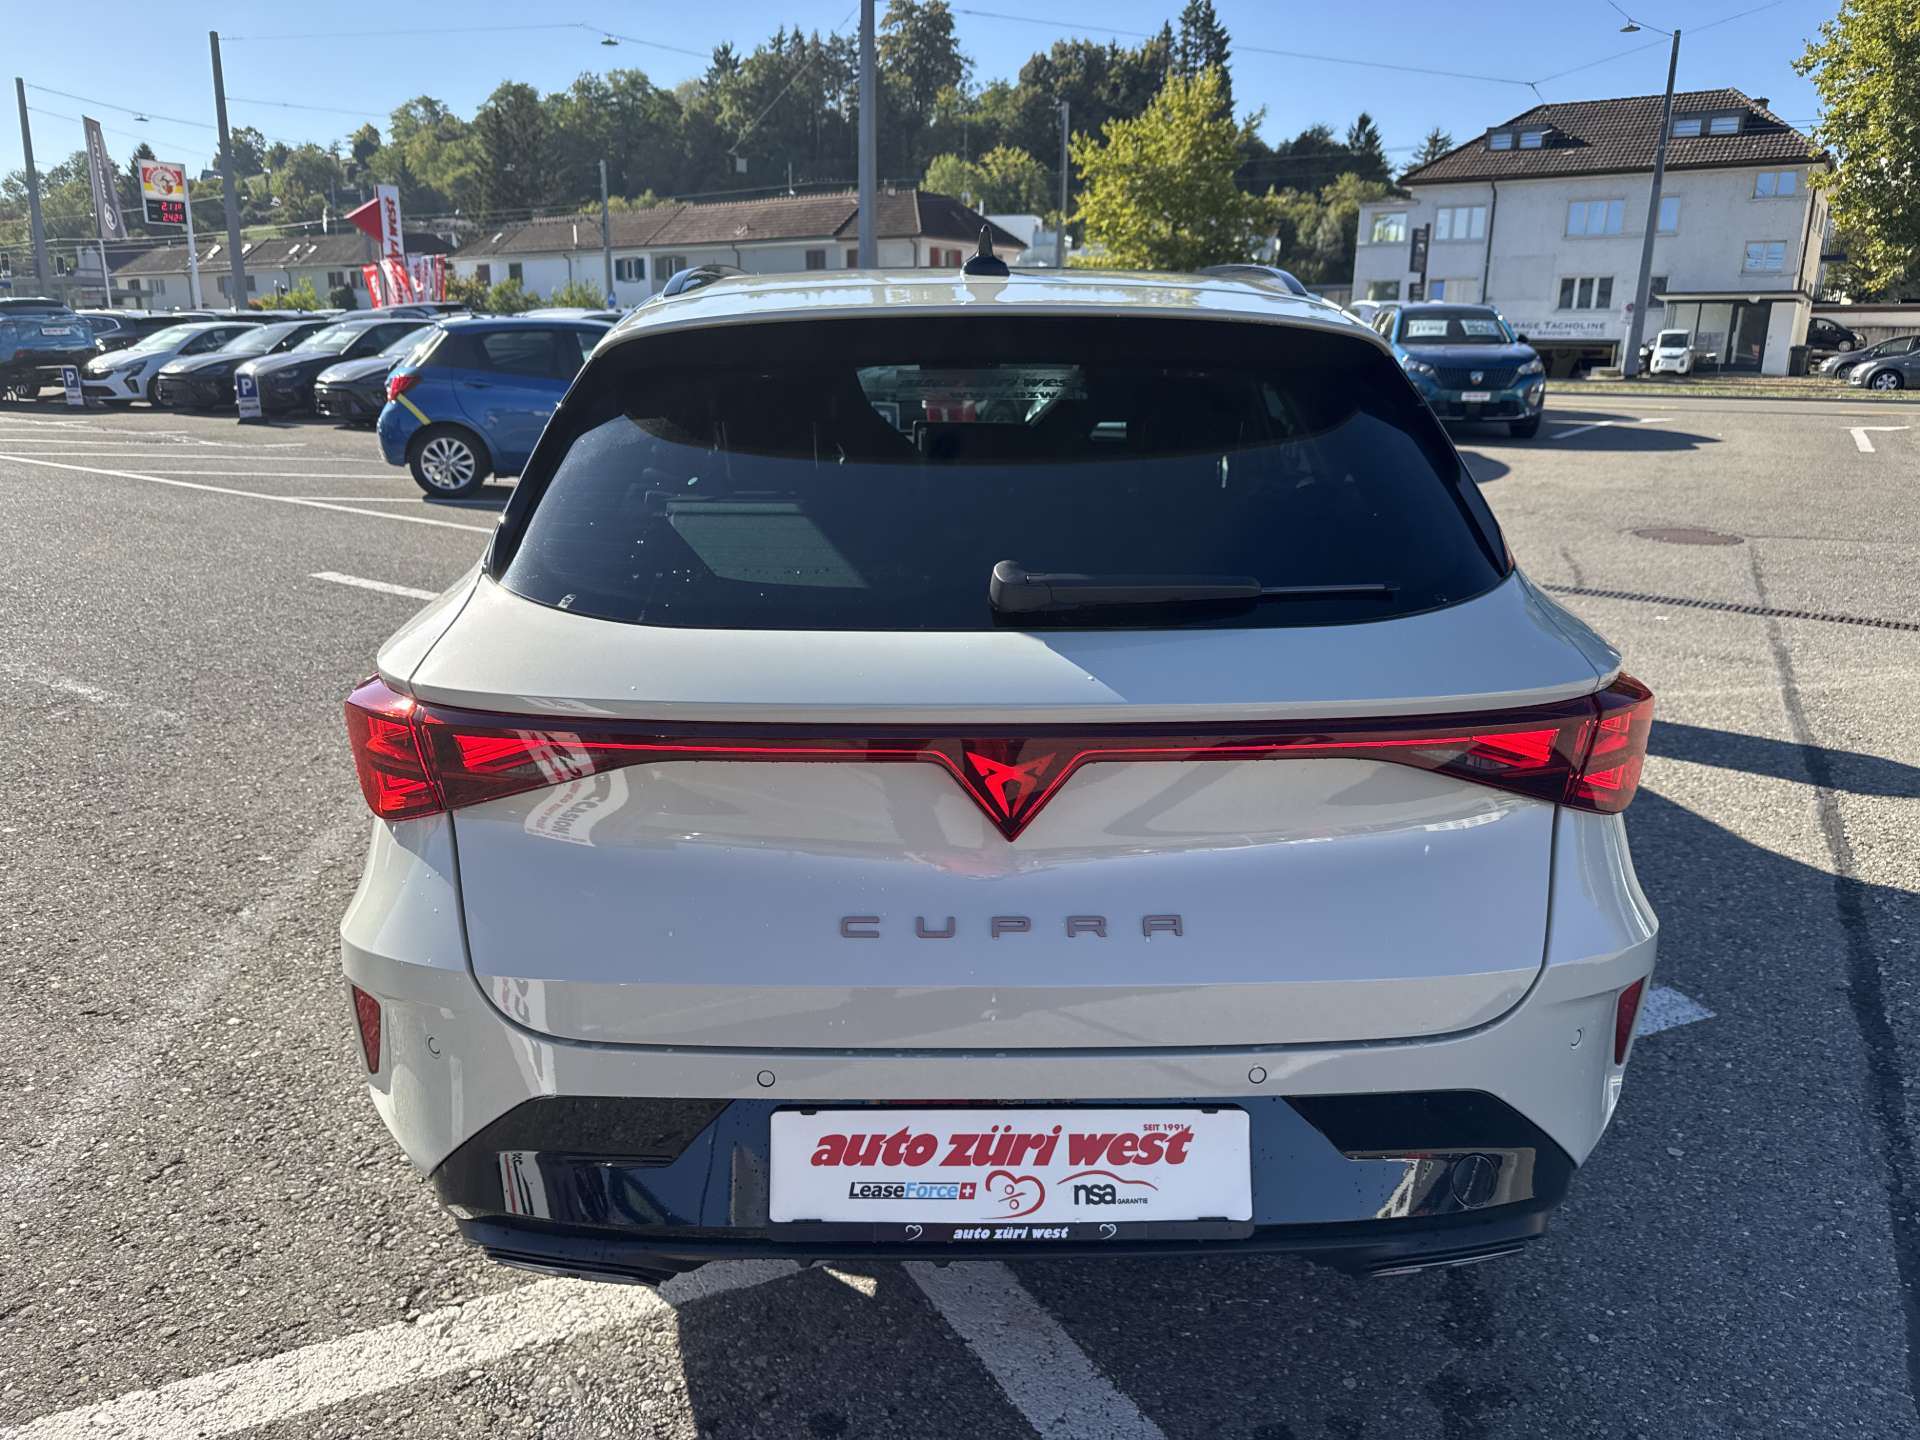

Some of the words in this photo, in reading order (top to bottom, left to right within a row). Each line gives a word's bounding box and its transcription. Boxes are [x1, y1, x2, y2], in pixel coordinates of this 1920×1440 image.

[66, 371, 75, 387] P
[241, 378, 252, 395] P
[840, 915, 1184, 939] CUPRA
[1143, 1123, 1160, 1132] SEIT
[1163, 1123, 1185, 1132] 1991
[810, 1125, 938, 1167] auto
[939, 1124, 1063, 1167] züri
[1068, 1124, 1194, 1167] west
[849, 1182, 959, 1198] LeaseForce
[1073, 1184, 1117, 1206] nsa
[1117, 1197, 1148, 1205] GARANTIE
[953, 1227, 991, 1239] auto
[993, 1226, 1029, 1239] züri
[1032, 1226, 1069, 1239] west
